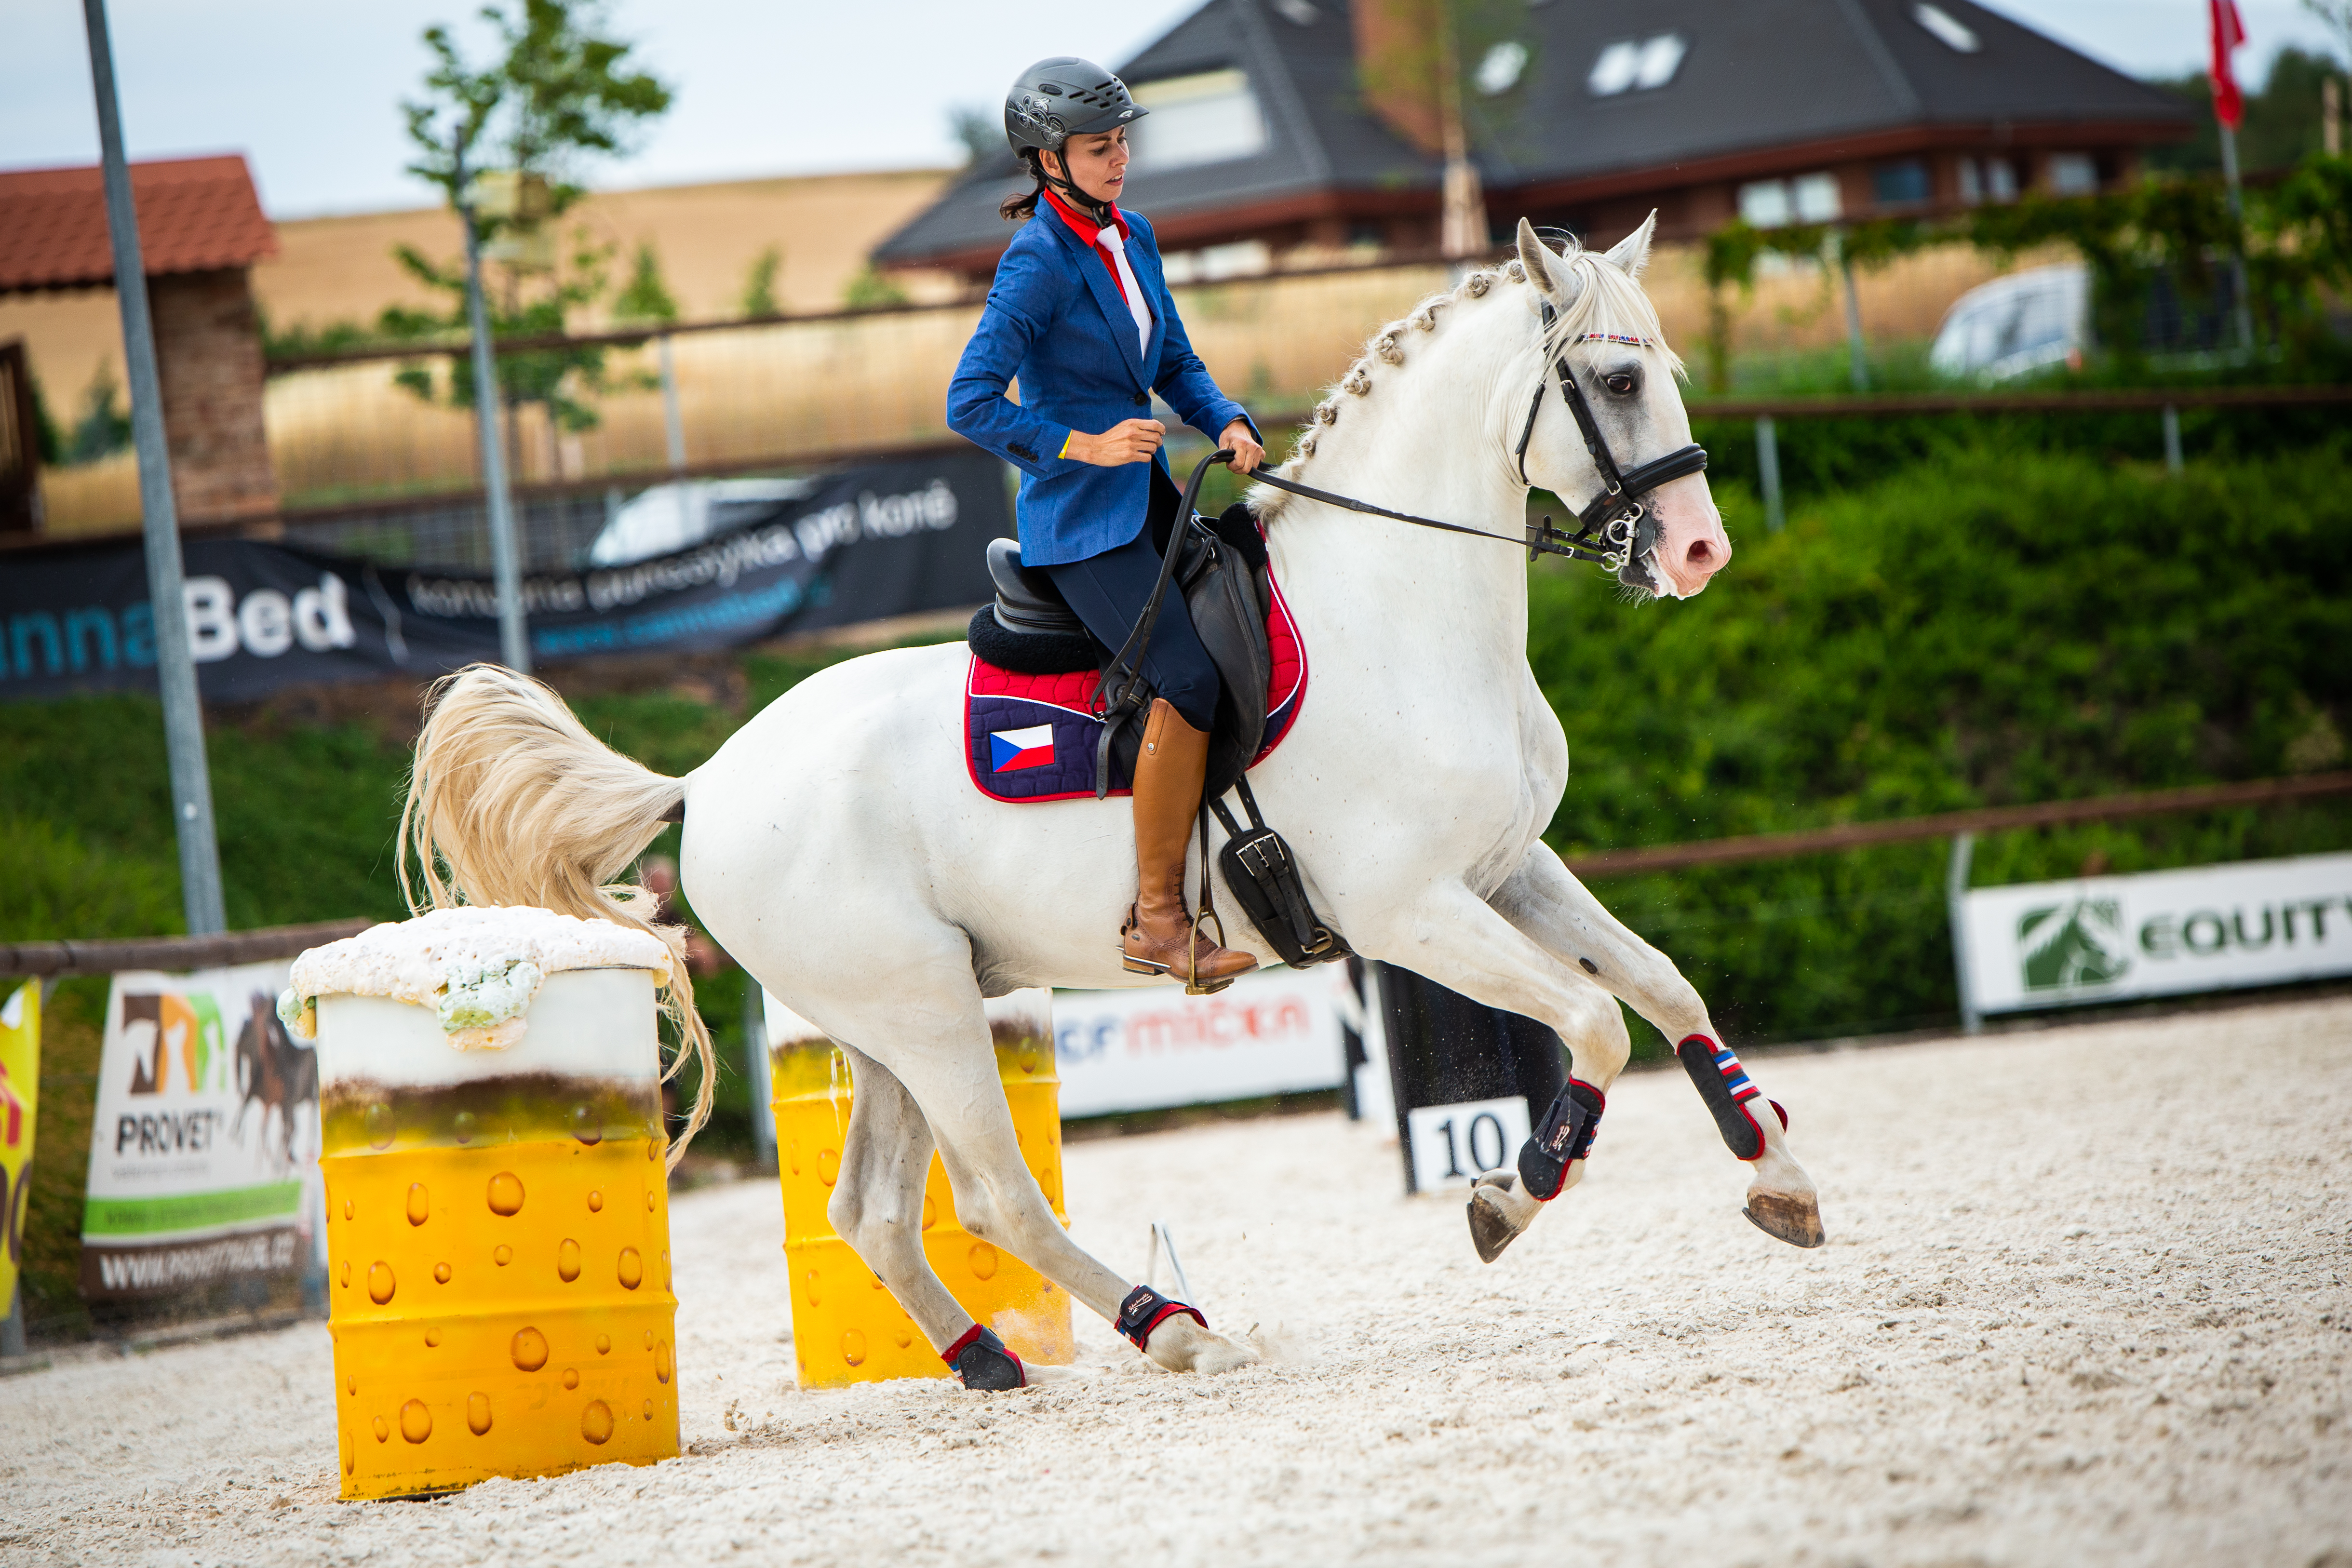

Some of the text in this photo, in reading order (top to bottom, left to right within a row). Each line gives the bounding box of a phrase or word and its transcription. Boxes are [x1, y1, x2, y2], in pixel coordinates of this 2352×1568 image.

[0, 572, 356, 674] nnaBed
[2139, 895, 2352, 960] EQUIT
[116, 1109, 212, 1157] PROVET
[1438, 1112, 1506, 1179] 10
